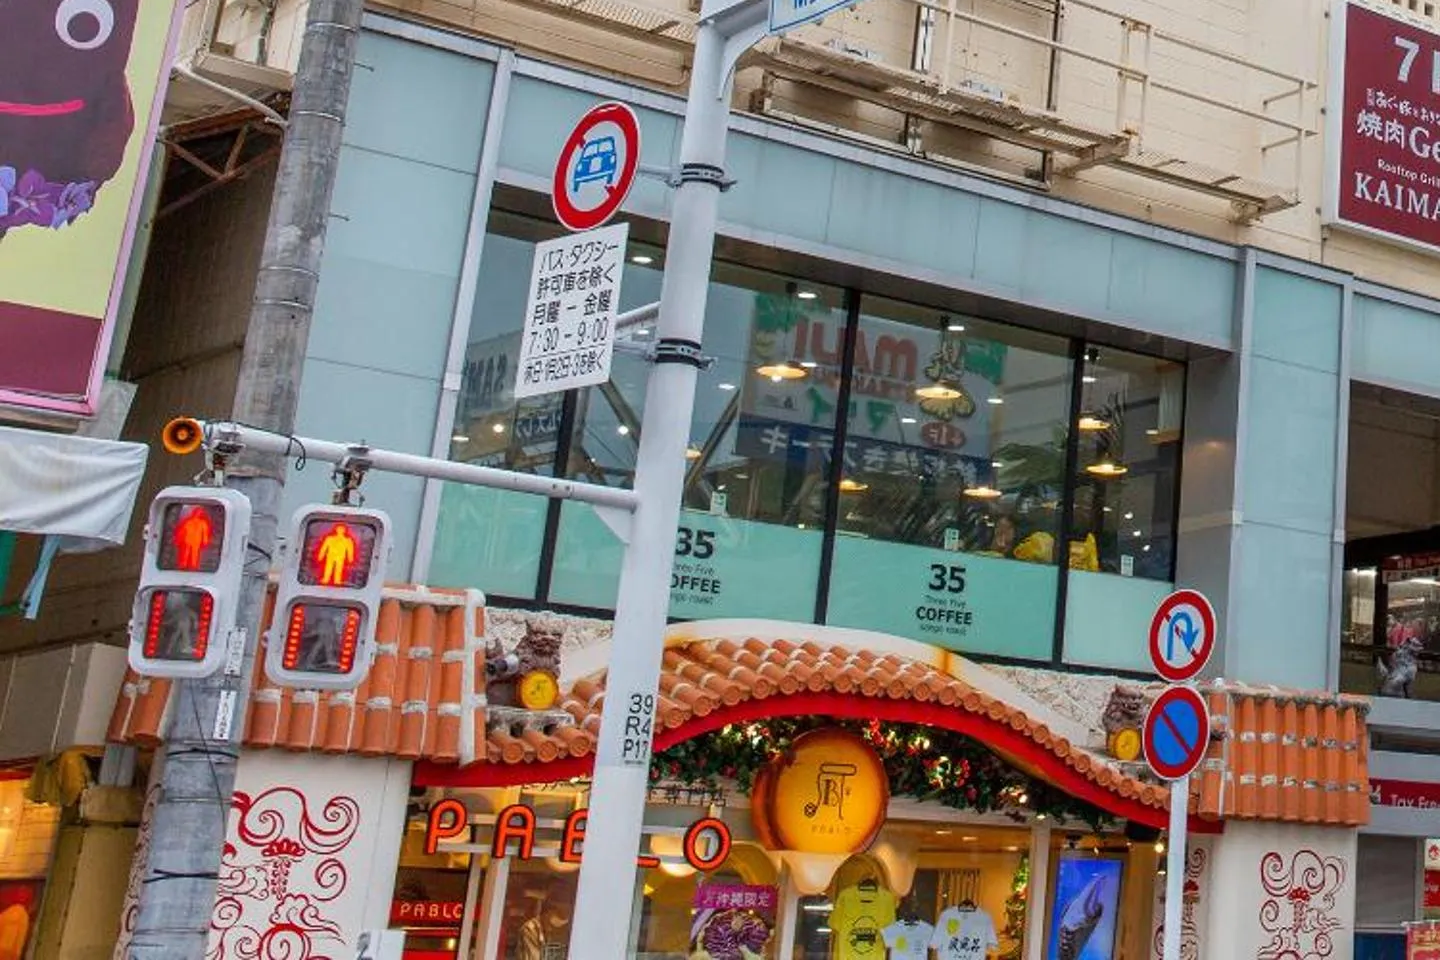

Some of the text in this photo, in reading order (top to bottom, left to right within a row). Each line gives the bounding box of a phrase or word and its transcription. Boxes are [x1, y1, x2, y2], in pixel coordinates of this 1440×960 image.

[928, 564, 966, 593] 35
[916, 606, 973, 625] COFFEE
[629, 694, 654, 715] 39
[626, 716, 652, 737] R4
